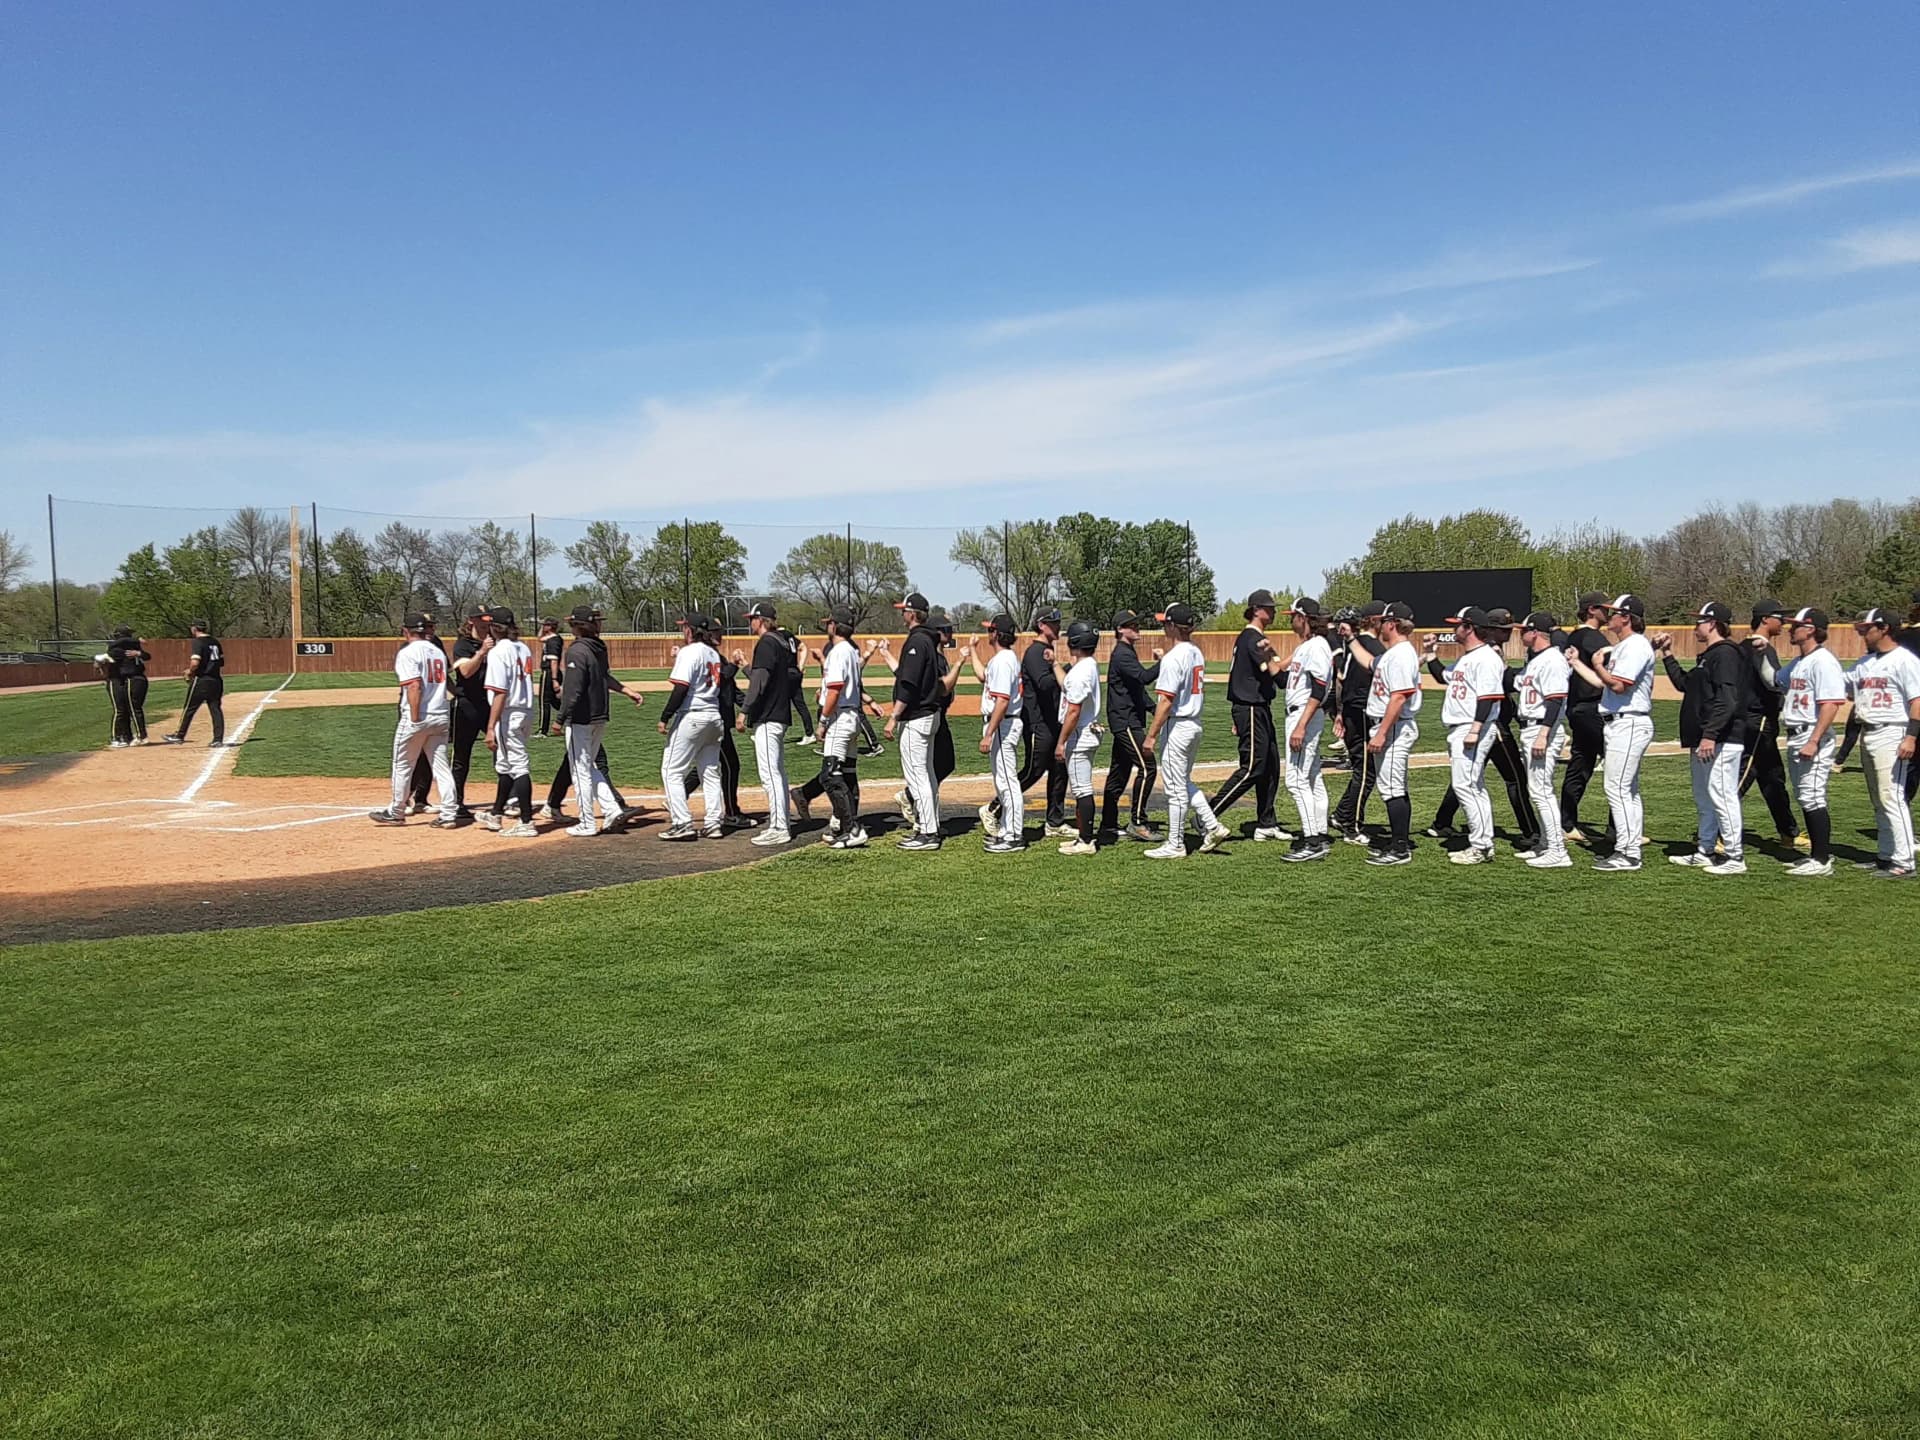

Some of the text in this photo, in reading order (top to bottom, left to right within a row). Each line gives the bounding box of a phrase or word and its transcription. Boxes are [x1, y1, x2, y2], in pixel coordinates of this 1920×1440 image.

[304, 644, 326, 654] 330
[427, 658, 446, 683] 18
[1451, 685, 1467, 700] 33
[1792, 693, 1809, 710] 24
